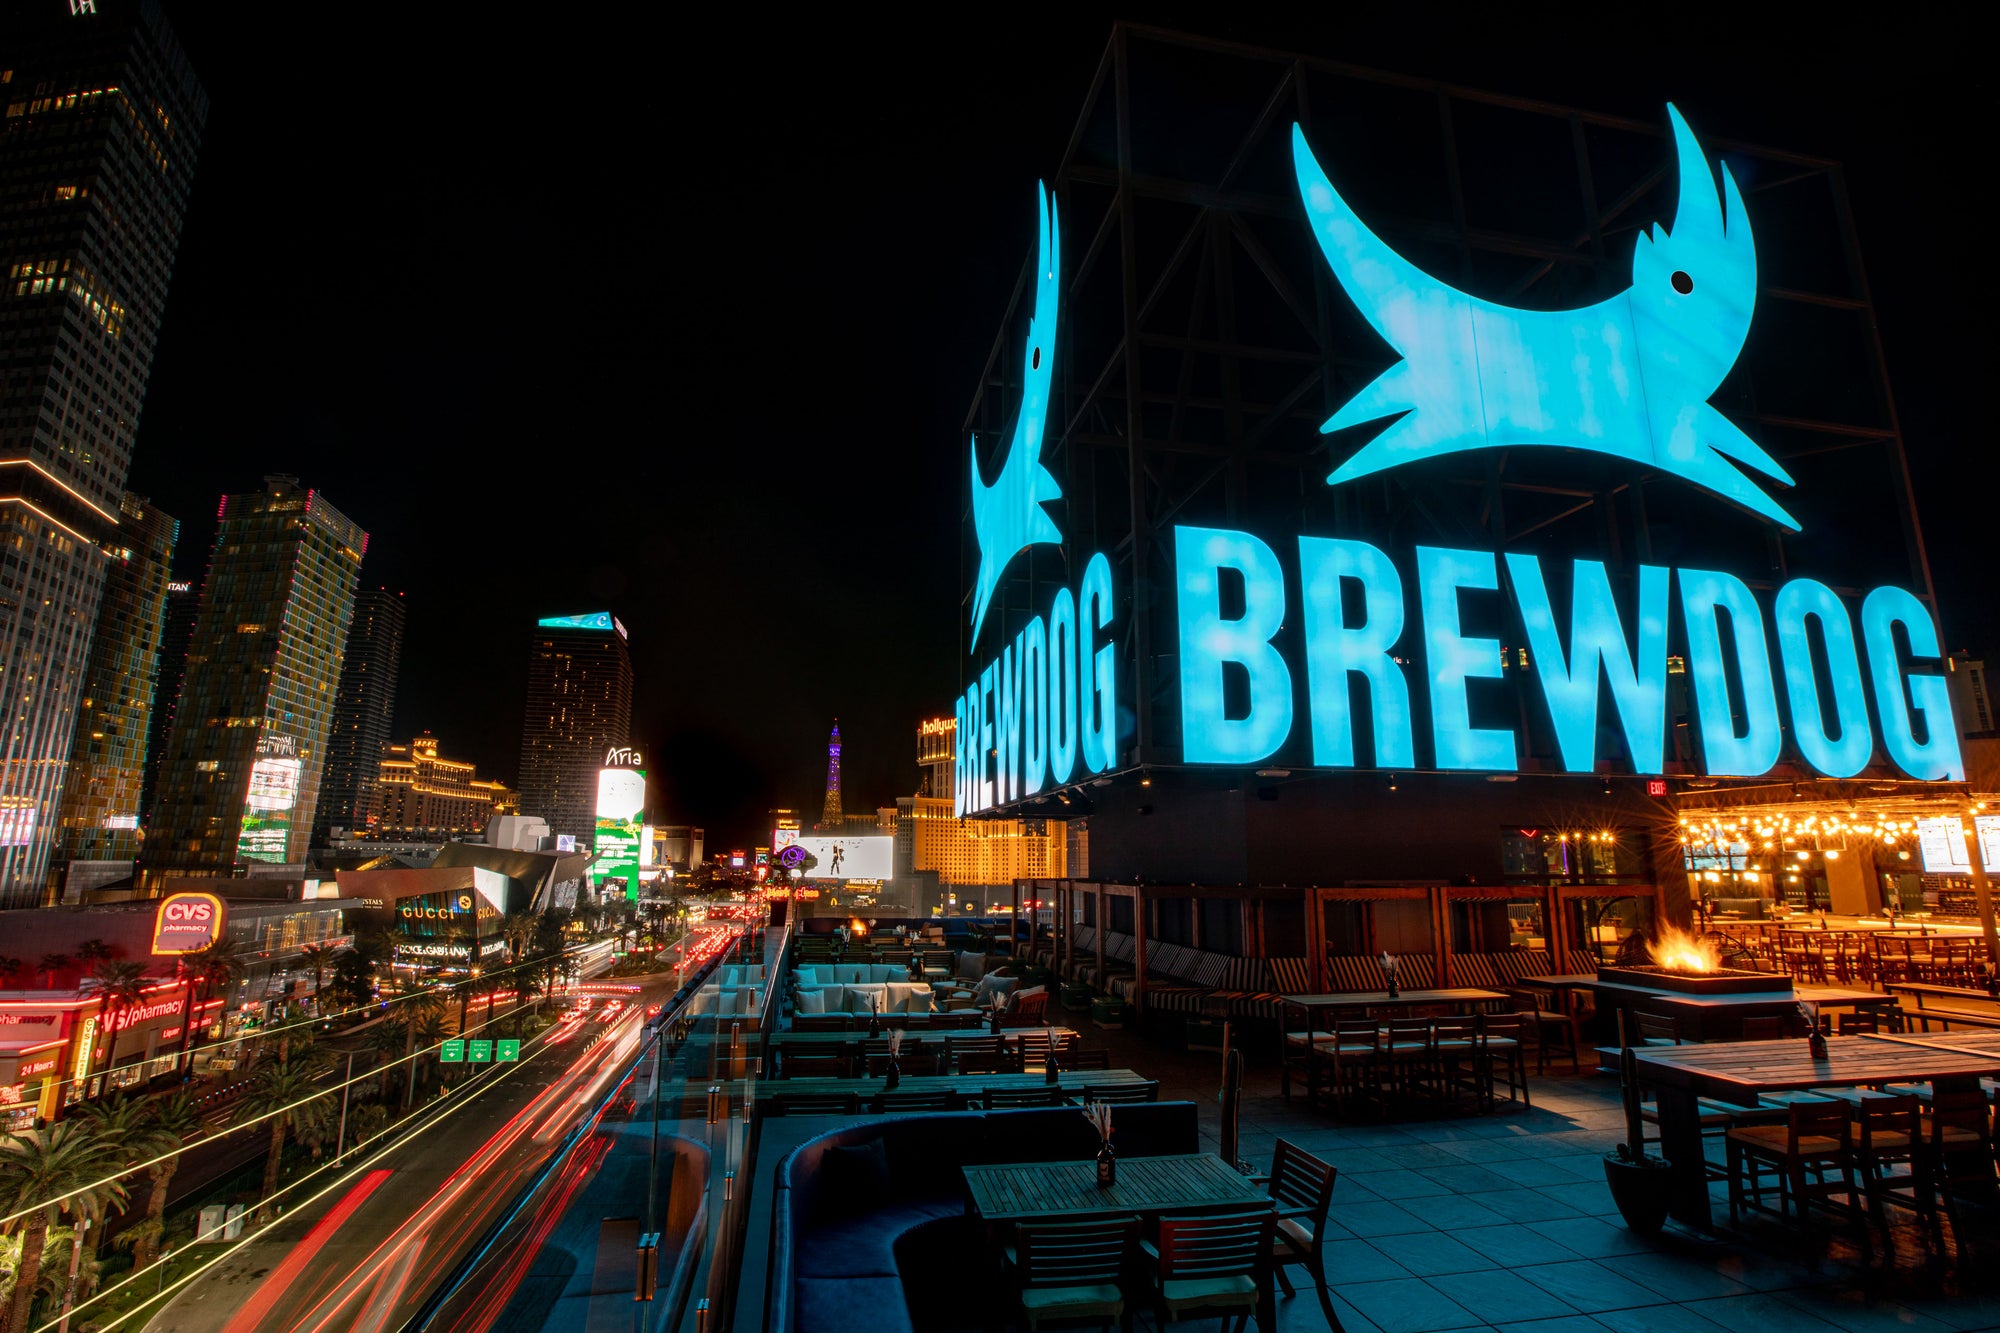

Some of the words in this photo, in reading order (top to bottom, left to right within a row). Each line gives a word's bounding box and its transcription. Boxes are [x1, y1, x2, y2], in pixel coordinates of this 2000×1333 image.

[1174, 525, 1965, 782] BREWDOG
[955, 552, 1116, 818] BREWDOG
[1650, 781, 1664, 795] EXIT
[165, 903, 212, 921] CVS
[402, 907, 455, 919] GUCCI
[477, 907, 496, 919] GUCCI
[163, 924, 208, 933] pharmacy
[21, 1064, 32, 1076] 24
[33, 1060, 54, 1073] Hours
